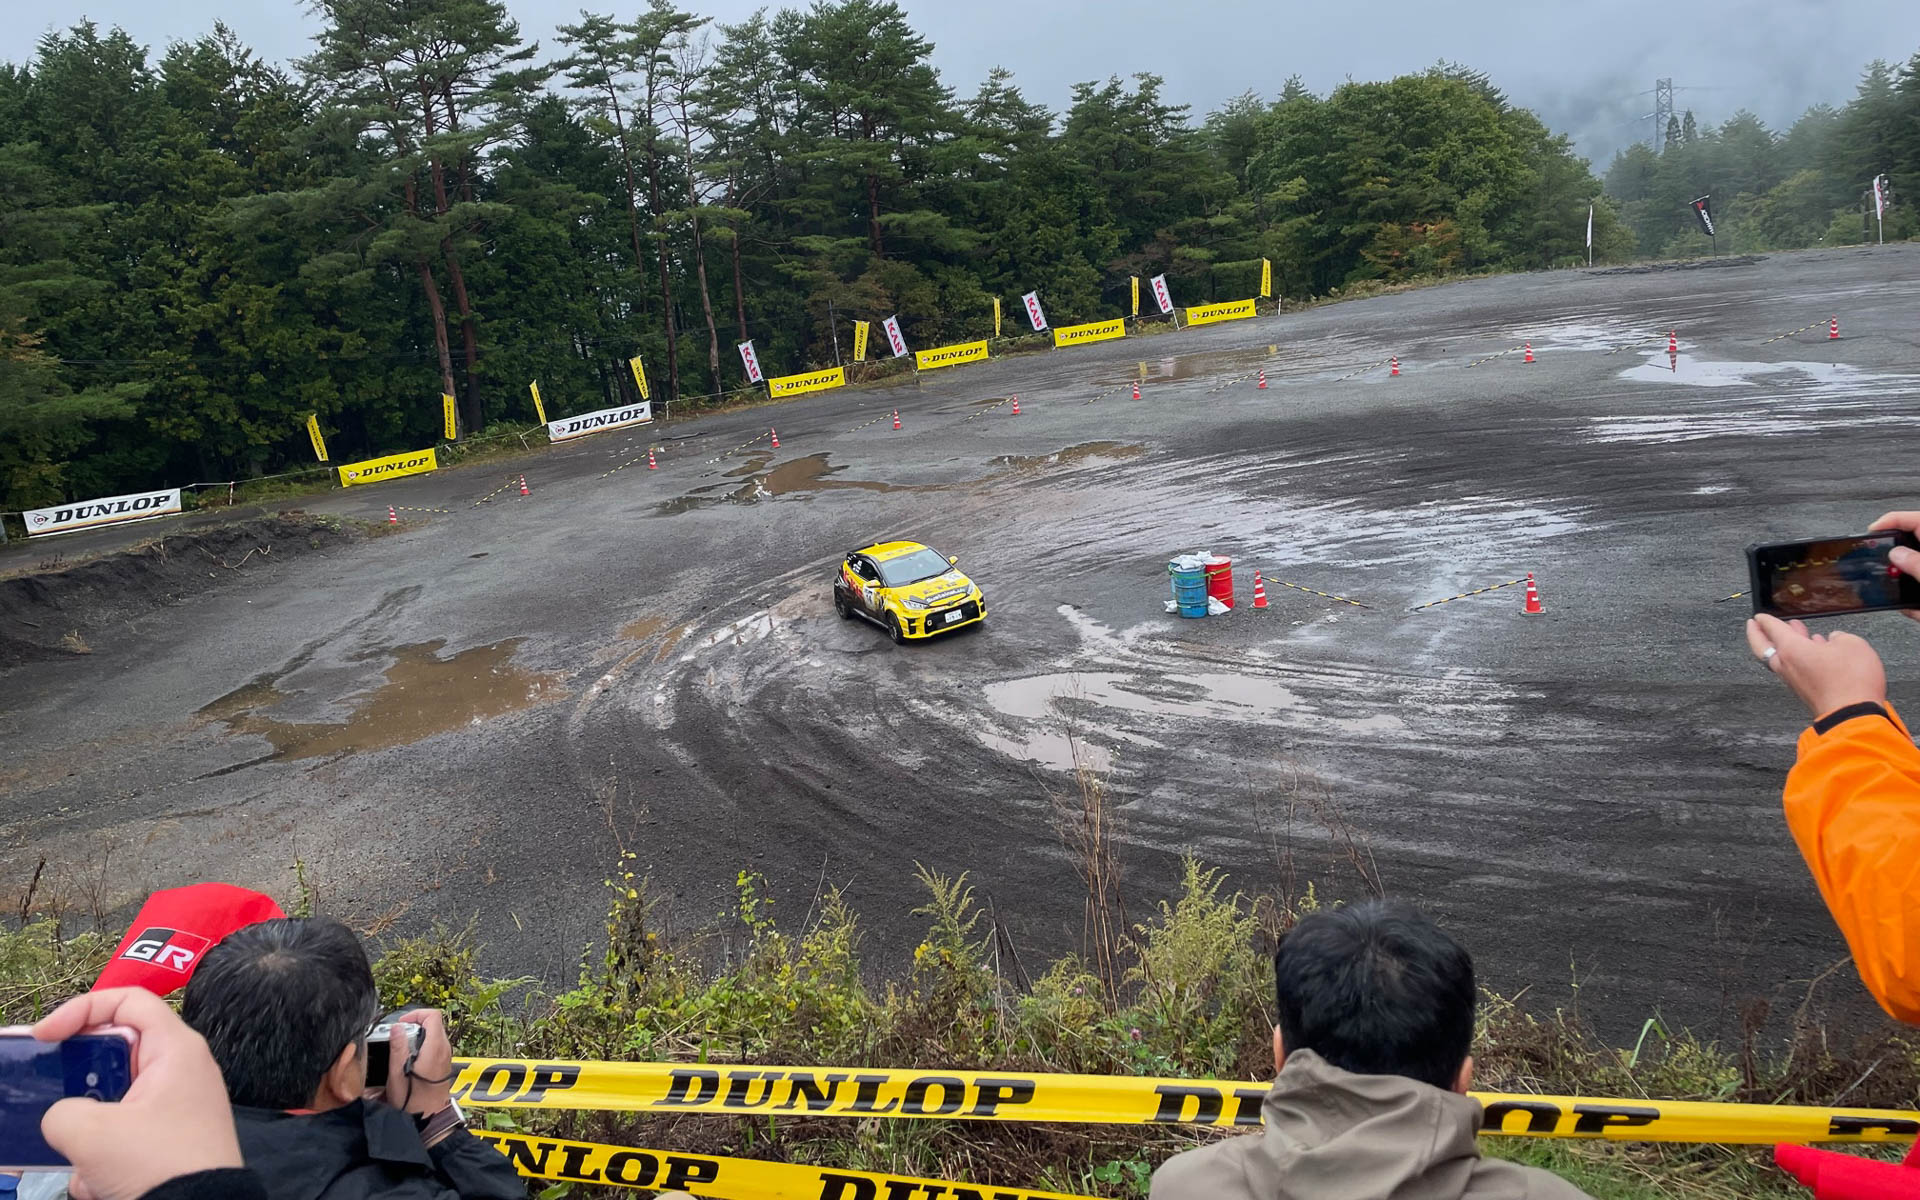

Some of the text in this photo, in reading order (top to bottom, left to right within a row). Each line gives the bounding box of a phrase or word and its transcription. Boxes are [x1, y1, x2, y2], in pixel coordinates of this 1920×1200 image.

[1201, 305, 1250, 318] DUNLOP
[1070, 325, 1119, 339] DUNLOP
[931, 347, 983, 362] DUNLOP
[786, 374, 839, 390] DUNLOP
[567, 407, 645, 433] DUNLOP
[361, 457, 429, 477] DUNLOP
[52, 495, 171, 523] DUNLOP
[125, 939, 195, 970] GR
[449, 1062, 581, 1102] LOP
[652, 1069, 1036, 1117] DUNLOP
[481, 1137, 719, 1191] NLOP
